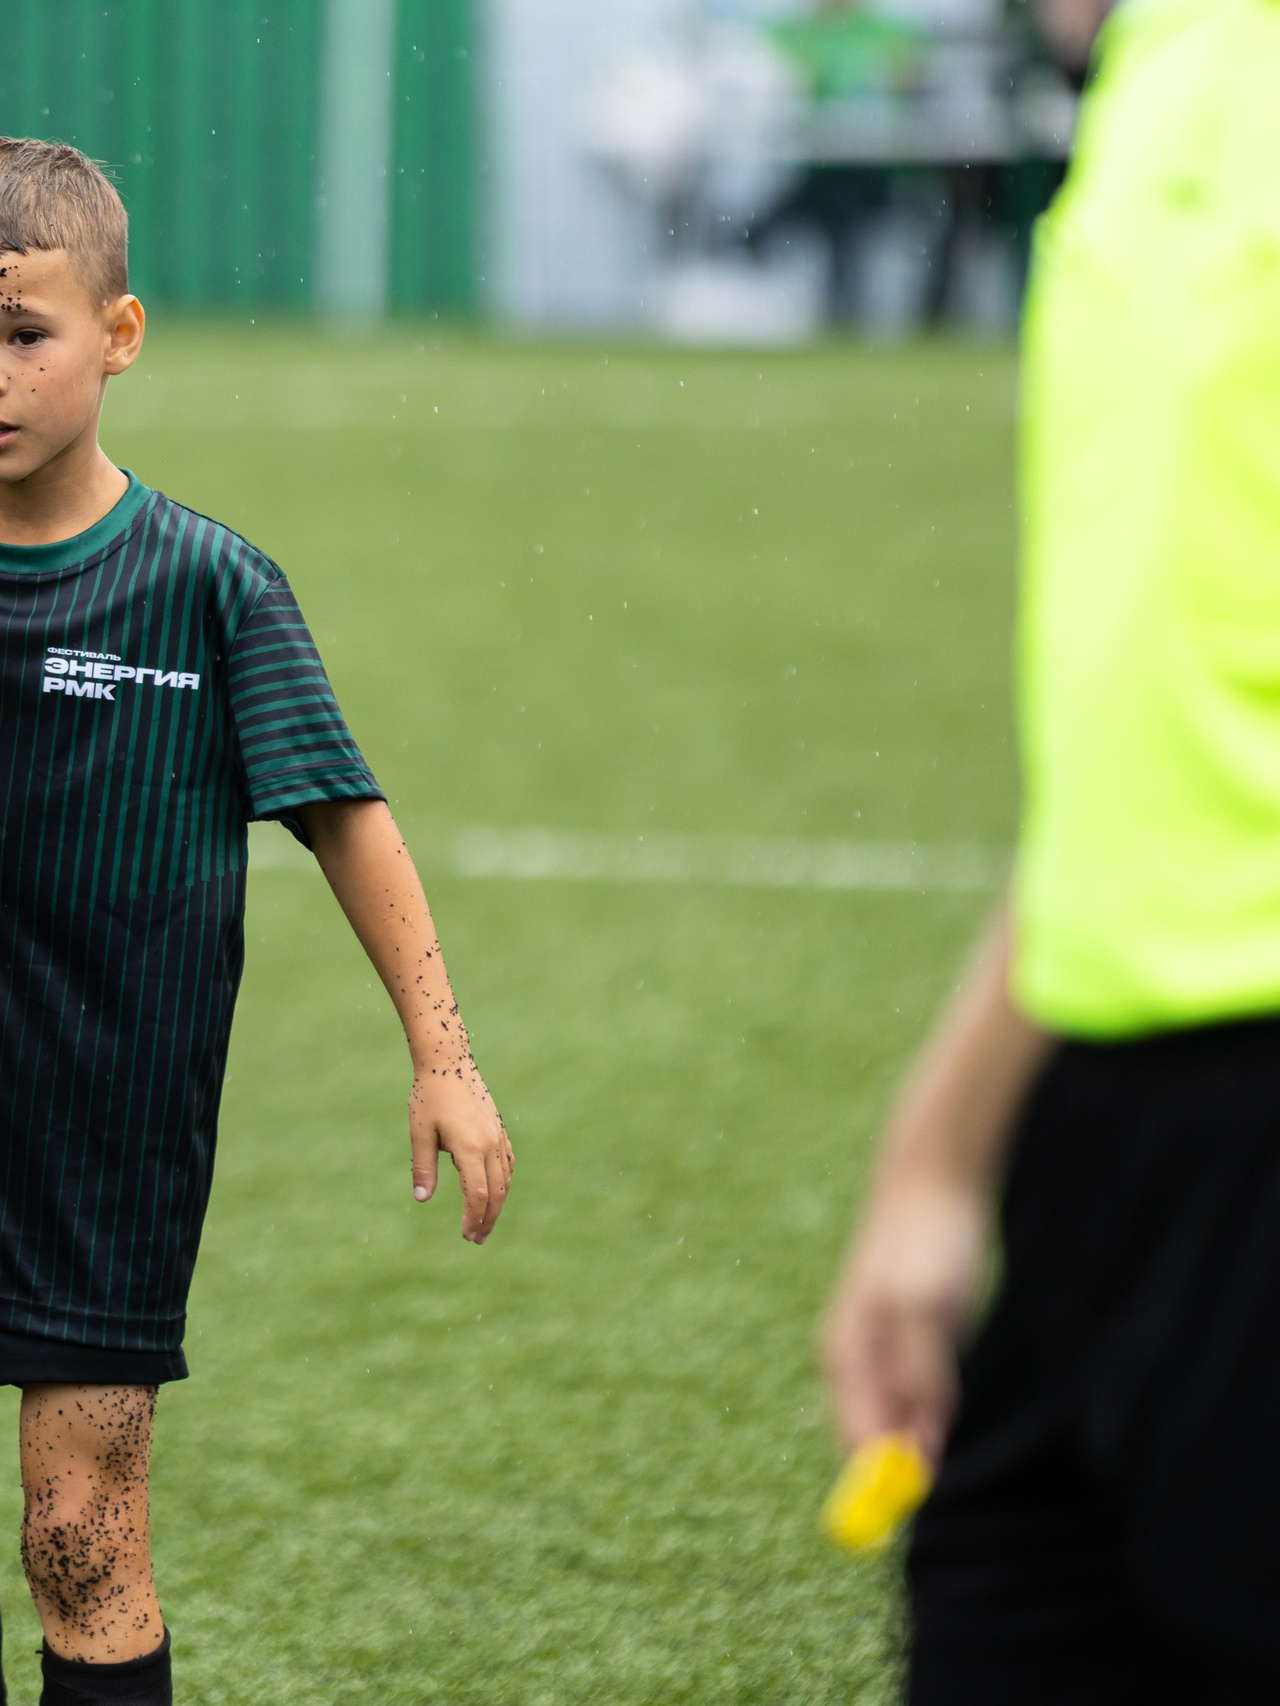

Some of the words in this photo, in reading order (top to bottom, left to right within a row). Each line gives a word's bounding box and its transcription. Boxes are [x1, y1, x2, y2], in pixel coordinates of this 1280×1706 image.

[47, 647, 121, 661] ФЕСТИВАЛЬ
[44, 657, 200, 690] ЭНЕРГИЯ
[42, 676, 117, 700] РМК
